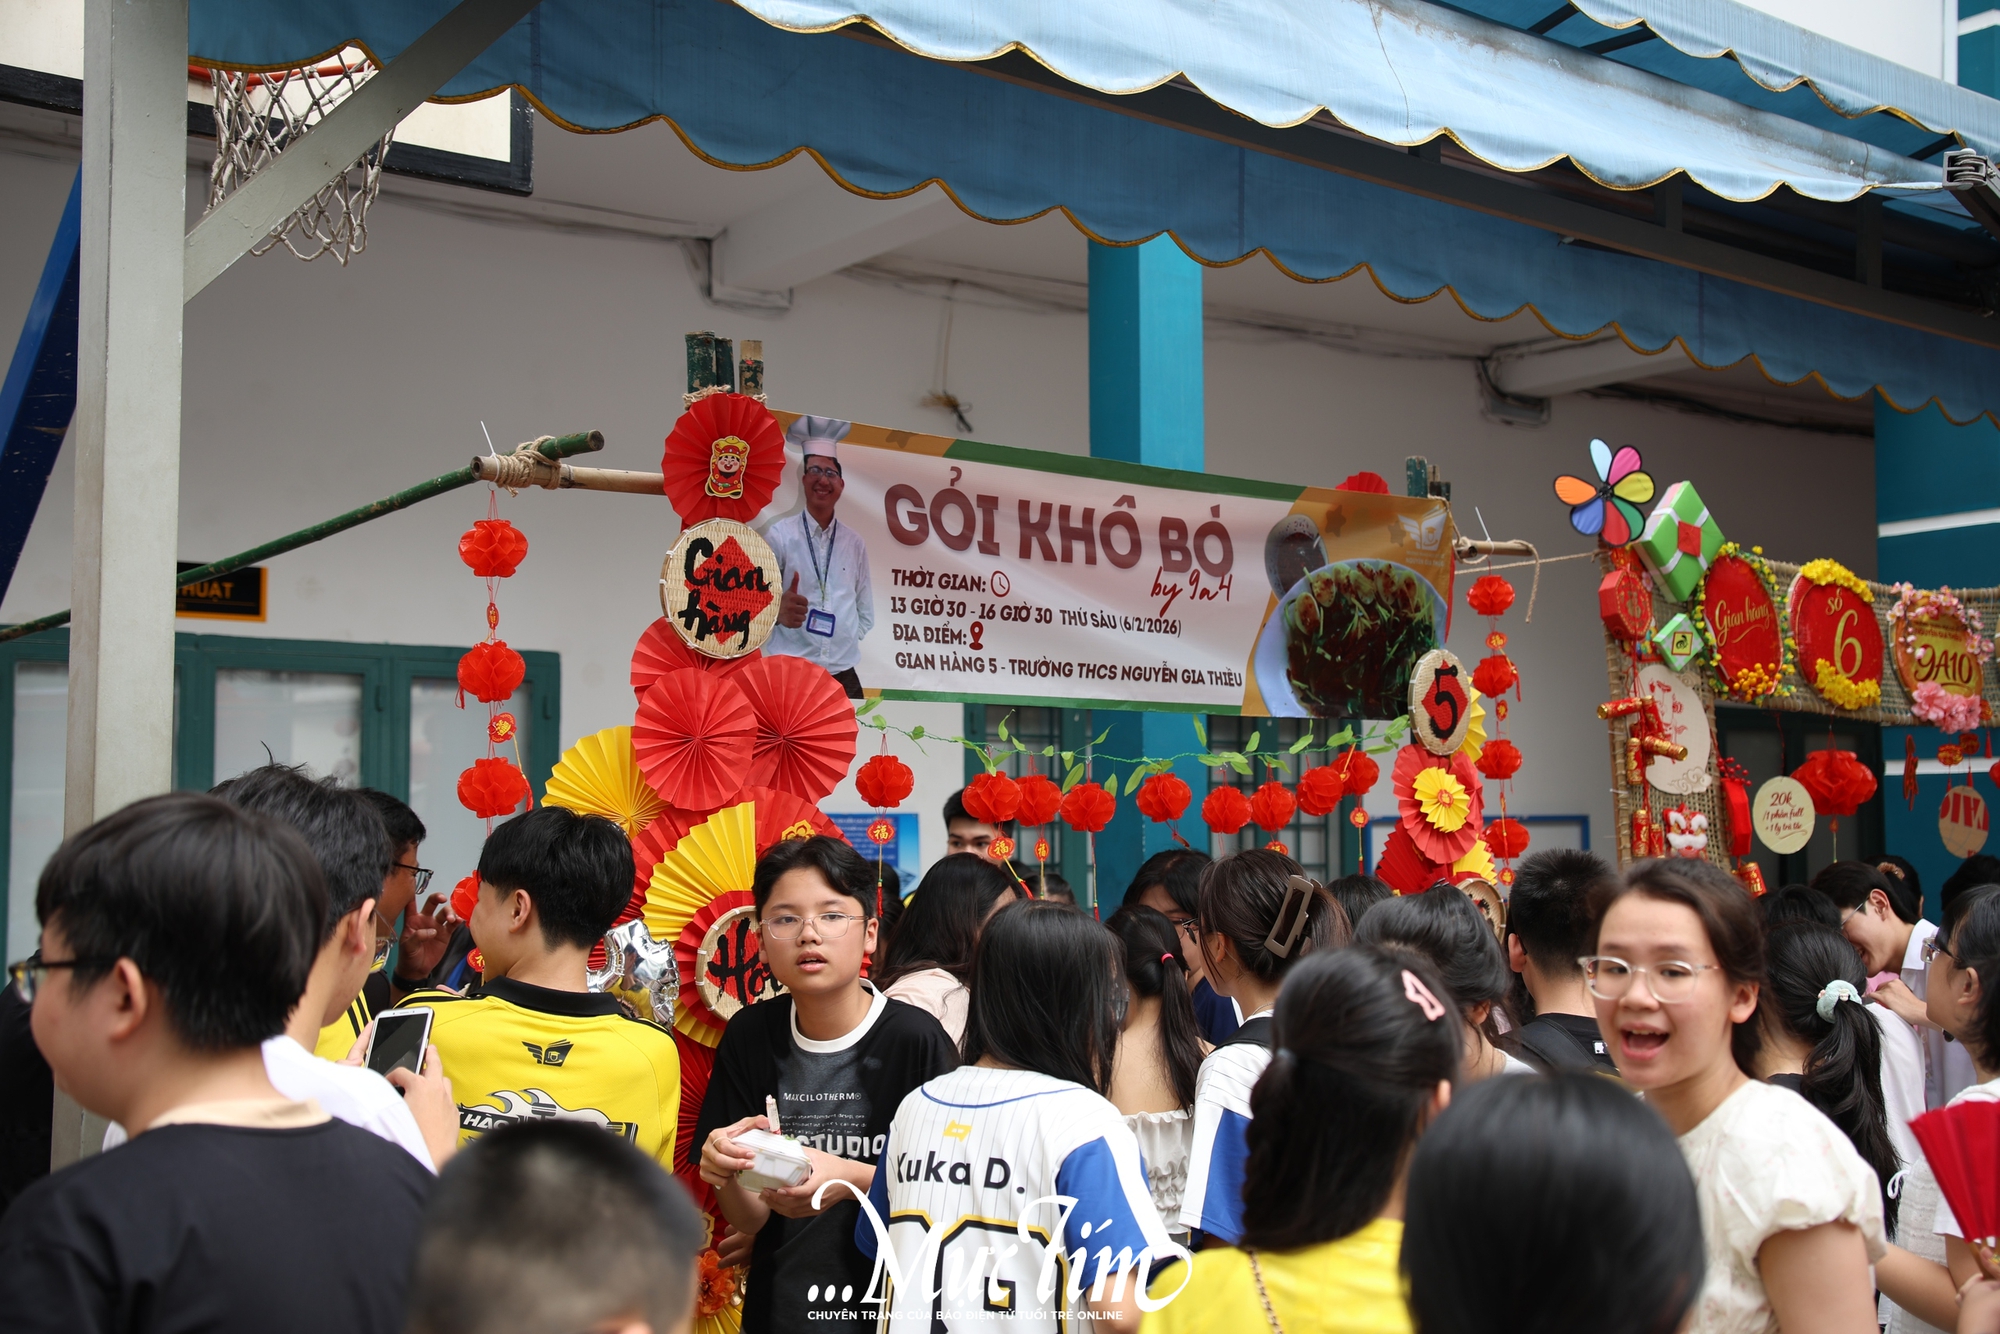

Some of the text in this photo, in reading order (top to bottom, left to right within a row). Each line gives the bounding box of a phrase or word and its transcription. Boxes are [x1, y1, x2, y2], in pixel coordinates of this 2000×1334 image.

[884, 466, 1001, 556] GỎI
[1018, 494, 1142, 569] KHÔ
[684, 537, 772, 592] Gian
[891, 566, 986, 593] THỜI GIAN:
[1150, 566, 1233, 618] by 9a4
[678, 588, 751, 650] hàng
[891, 596, 907, 614] 13
[911, 594, 945, 616] GIỜ
[946, 601, 967, 618] 30
[978, 603, 996, 620] 16
[1000, 601, 1033, 622] GIỜ
[1034, 608, 1053, 624] 30
[1060, 607, 1087, 626] THỨ
[1120, 616, 1182, 638] (6/2/2026)
[893, 621, 967, 645] ĐỊA ĐIỂM:
[1715, 596, 1770, 647] Gian hàng
[1834, 609, 1863, 678] 6
[1914, 643, 1973, 684] 9A10
[895, 652, 935, 671] GIAN
[940, 651, 985, 673] HÀNG
[988, 658, 997, 674] 5
[1008, 656, 1073, 678] TRƯỜNG
[1077, 663, 1117, 680] THCS
[1121, 661, 1178, 683] NGUYỄN
[1181, 668, 1205, 685] GIA
[1429, 664, 1458, 740] 5
[873, 825, 889, 840] 福
[984, 1157, 1026, 1194] D.
